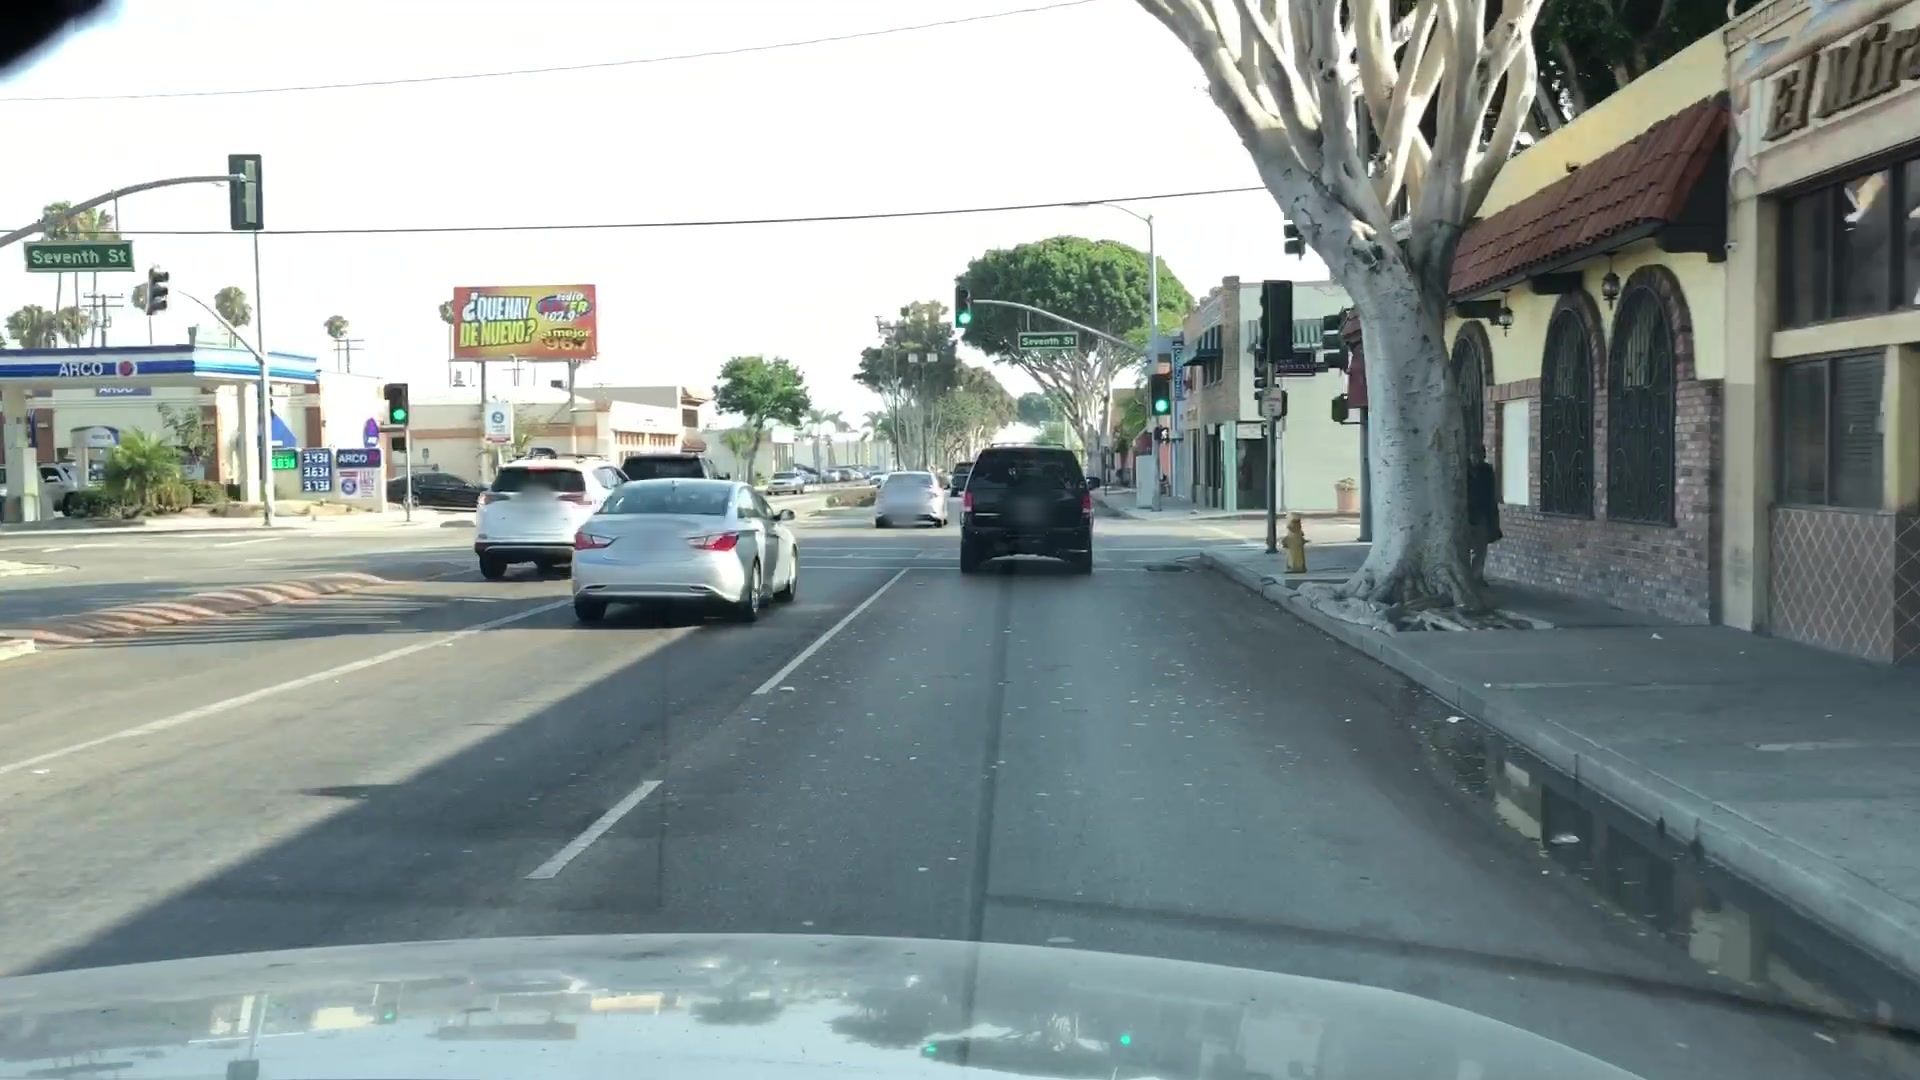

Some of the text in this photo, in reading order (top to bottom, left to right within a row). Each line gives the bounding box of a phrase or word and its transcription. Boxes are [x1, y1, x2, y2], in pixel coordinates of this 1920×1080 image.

[1761, 54, 1820, 141] El
[32, 249, 127, 264] Seventh St
[459, 319, 536, 346] DE NUEVO?
[553, 329, 591, 338] mejor
[1022, 336, 1074, 346] Seventh St
[59, 362, 104, 377] ARCO
[338, 454, 368, 464] ARCO
